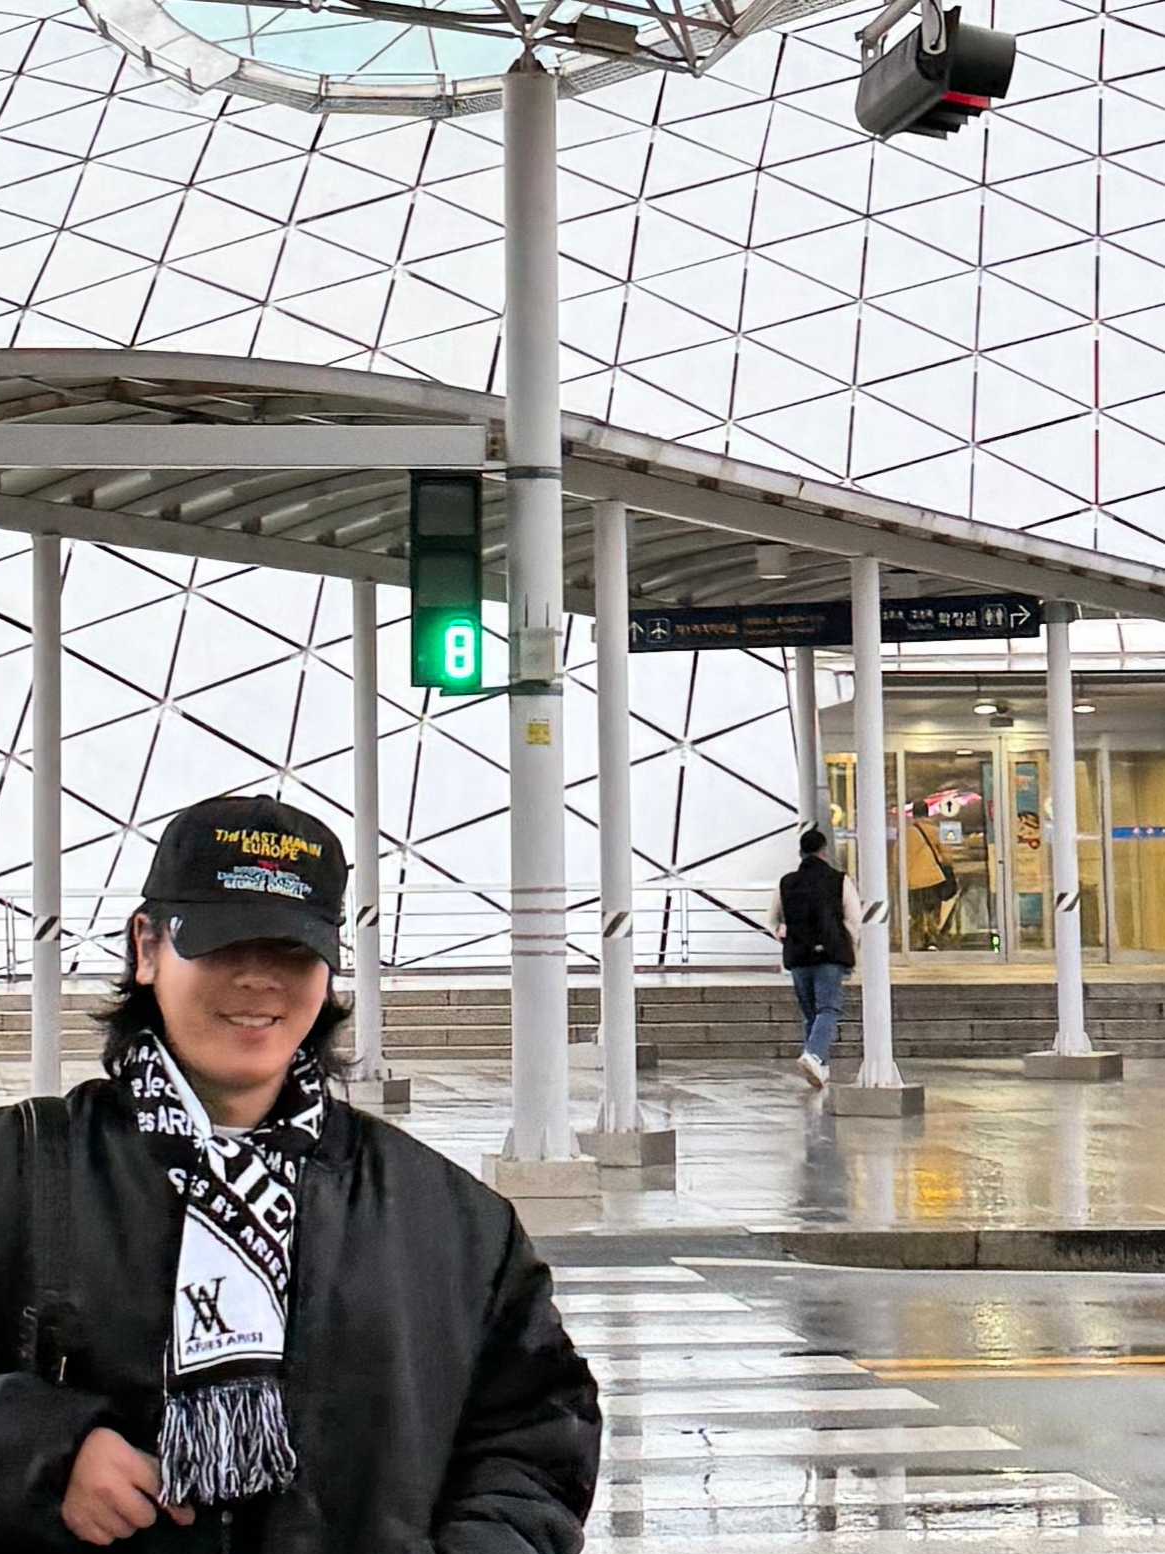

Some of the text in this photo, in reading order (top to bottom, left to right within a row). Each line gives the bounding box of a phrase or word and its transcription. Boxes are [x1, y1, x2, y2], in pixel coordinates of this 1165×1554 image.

[445, 624, 475, 679] 8
[241, 829, 278, 846] LAST
[242, 838, 299, 861] EUROPE
